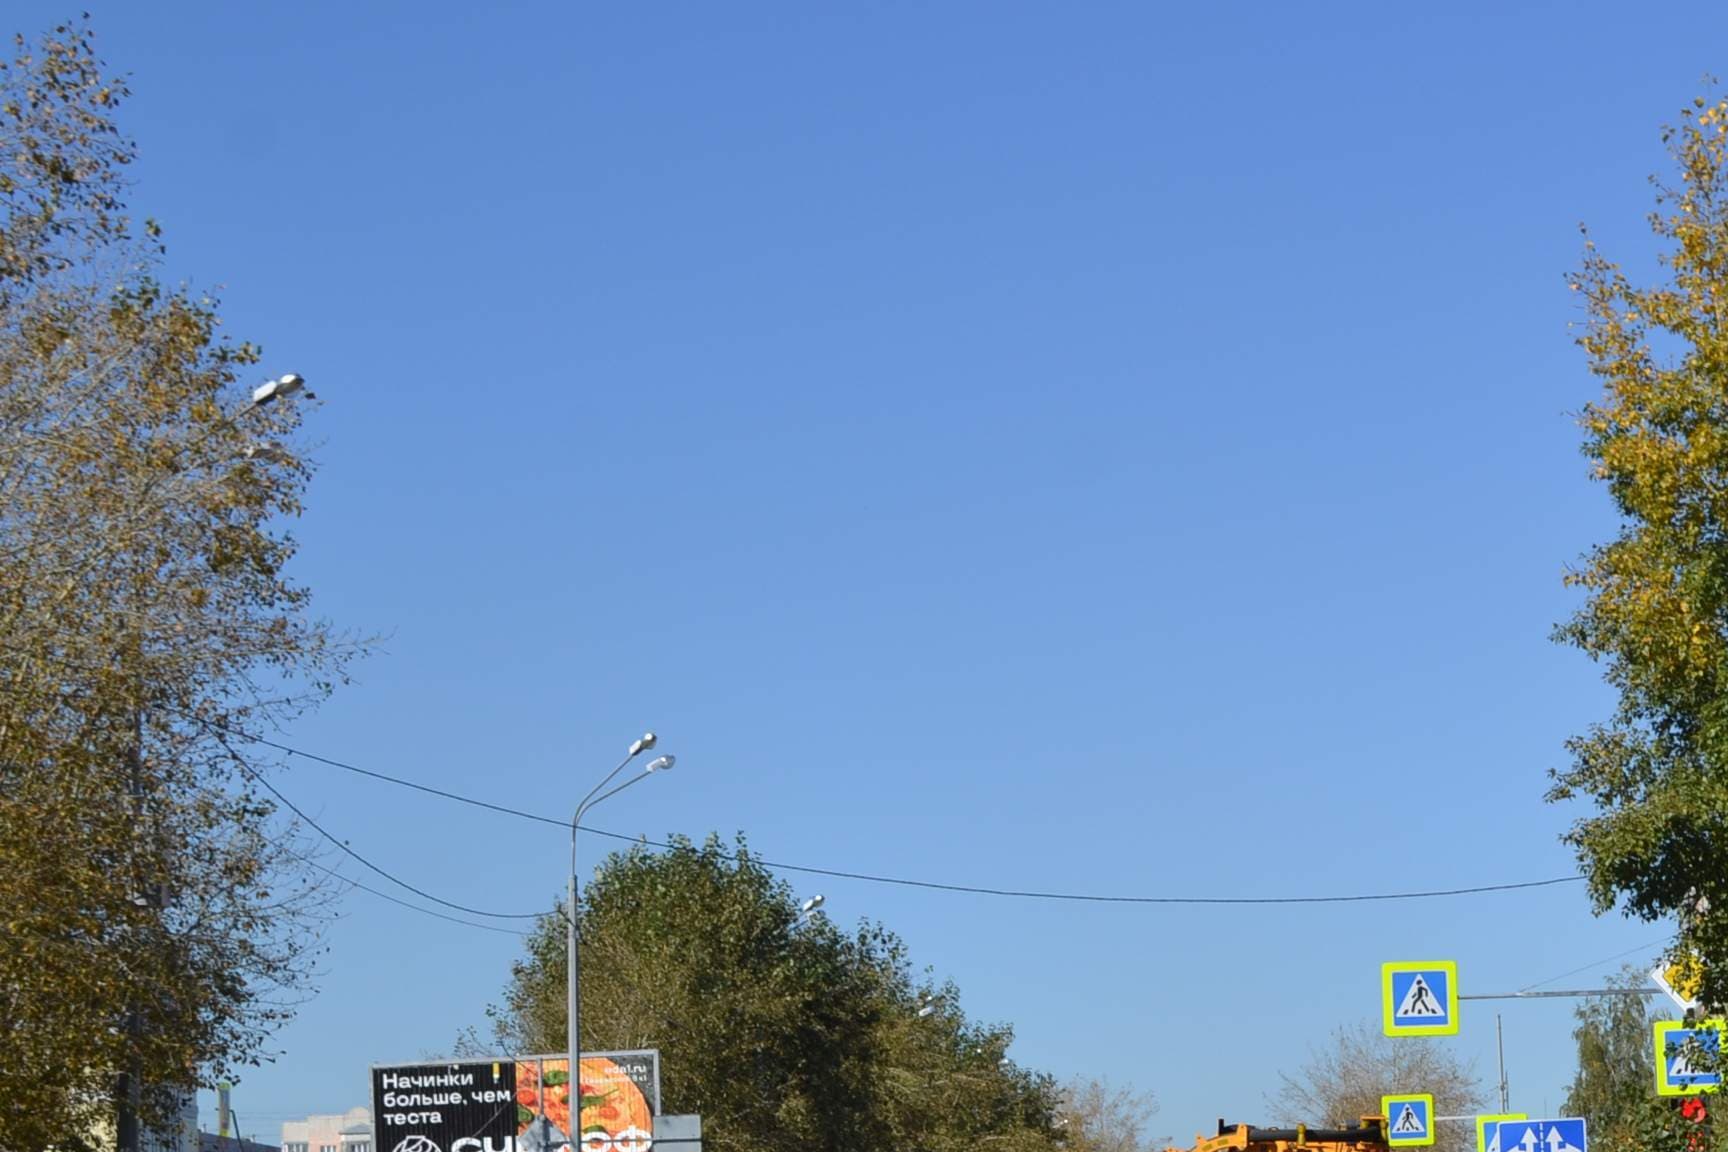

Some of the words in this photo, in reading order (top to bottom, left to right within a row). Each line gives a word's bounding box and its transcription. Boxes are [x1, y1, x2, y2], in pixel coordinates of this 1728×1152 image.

[382, 1073, 474, 1090] Начинки
[383, 1091, 468, 1107] больше,
[471, 1089, 512, 1103] чем
[383, 1111, 443, 1126] теста
